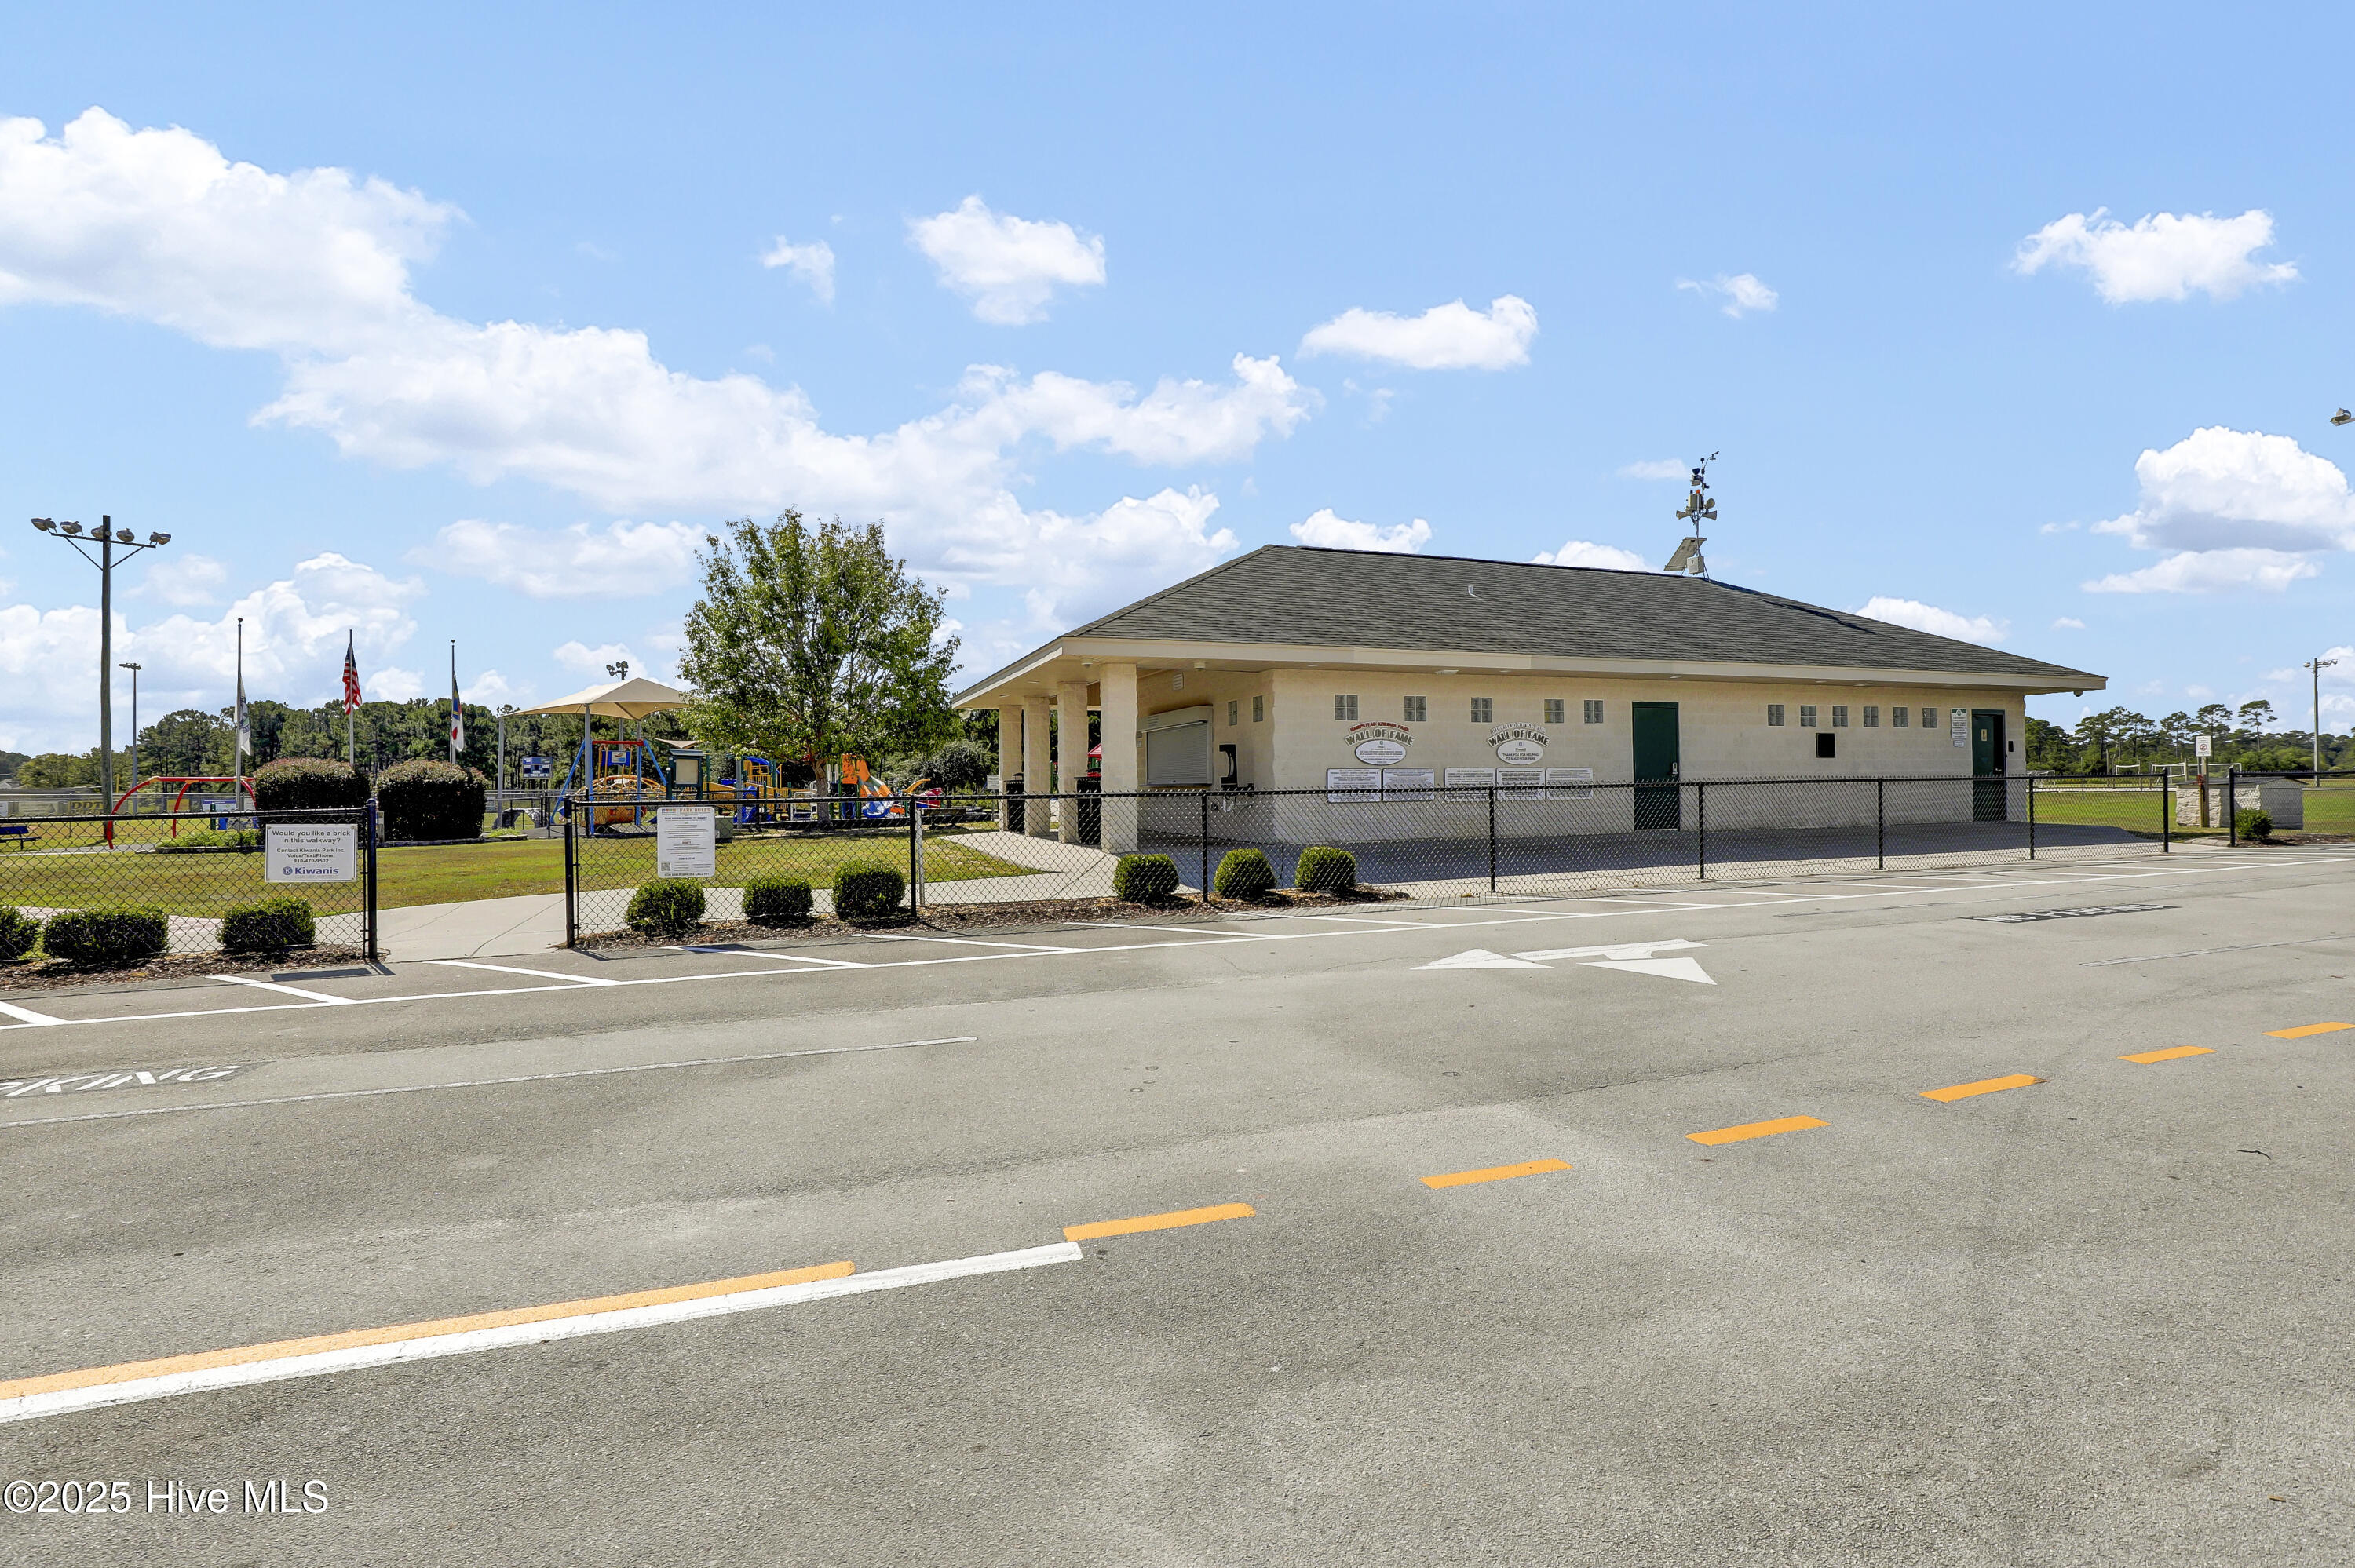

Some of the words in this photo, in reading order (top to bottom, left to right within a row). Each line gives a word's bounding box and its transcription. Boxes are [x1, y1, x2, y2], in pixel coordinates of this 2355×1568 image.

[1345, 731, 1371, 746] WALL
[1374, 728, 1388, 738] OF
[1389, 730, 1414, 746] FAME
[1488, 731, 1512, 746] WALL
[1513, 729, 1525, 738] OF
[1528, 731, 1550, 746] FAME
